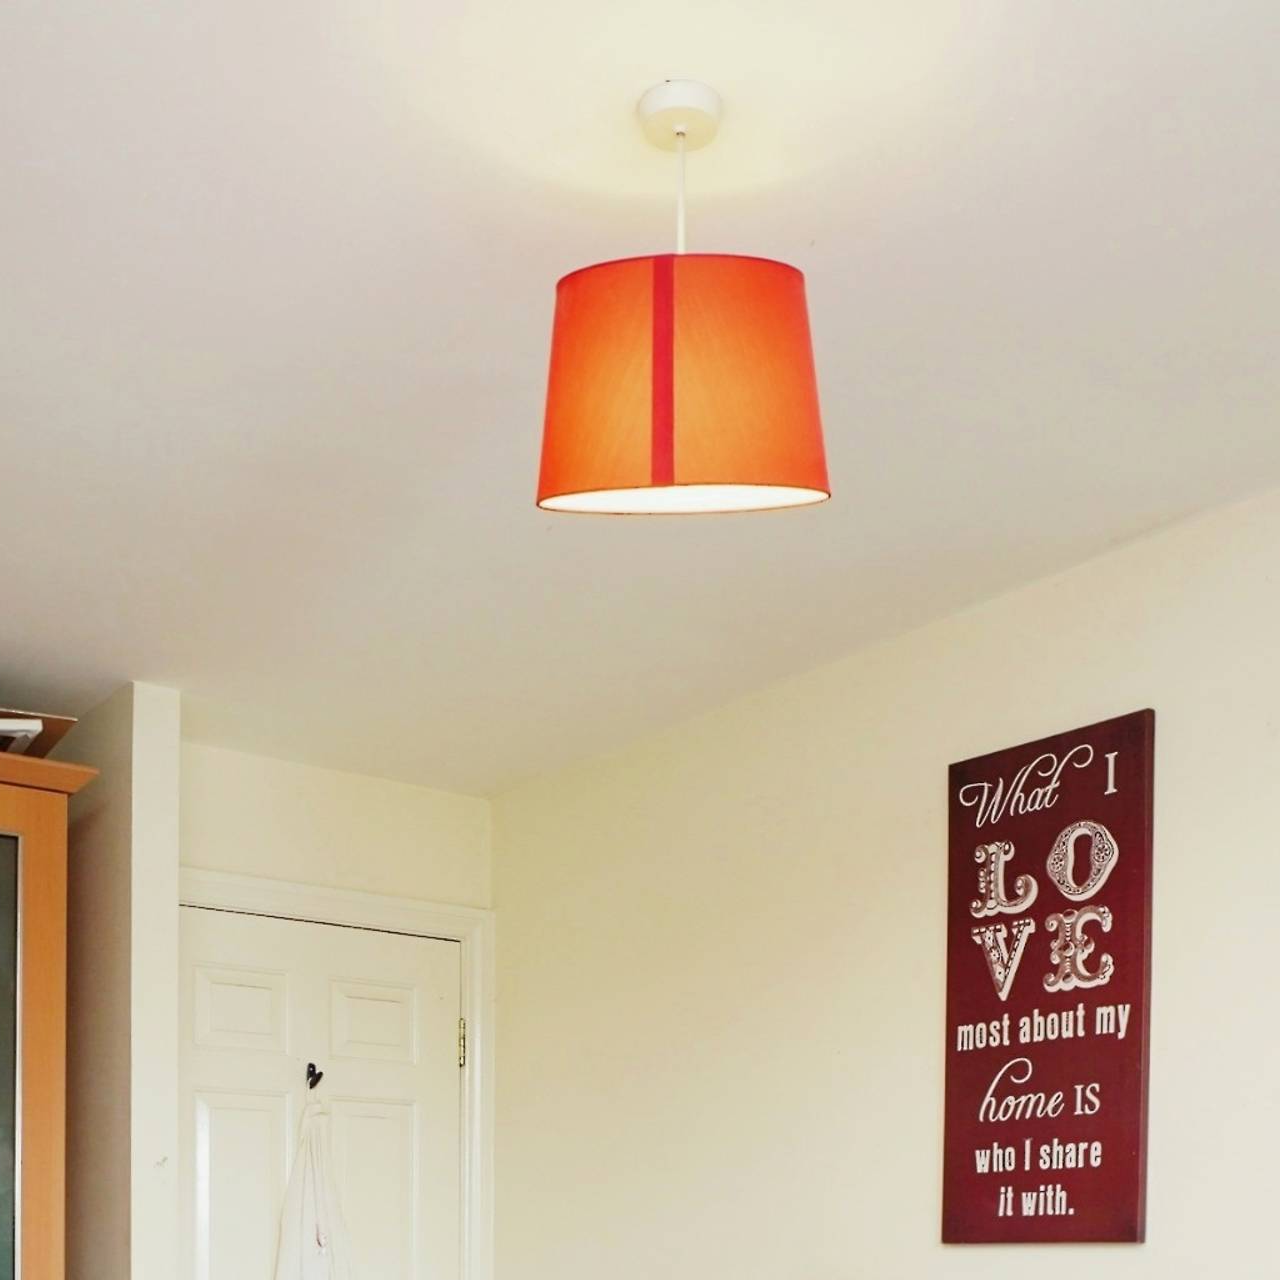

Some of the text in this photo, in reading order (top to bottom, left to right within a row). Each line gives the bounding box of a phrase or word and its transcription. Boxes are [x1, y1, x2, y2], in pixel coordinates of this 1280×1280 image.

[959, 744, 1119, 828] What I
[957, 1003, 1131, 1051] most about my
[978, 1057, 1101, 1122] home IS
[975, 1138, 1102, 1174] who I share
[998, 1184, 1075, 1217] it with.
